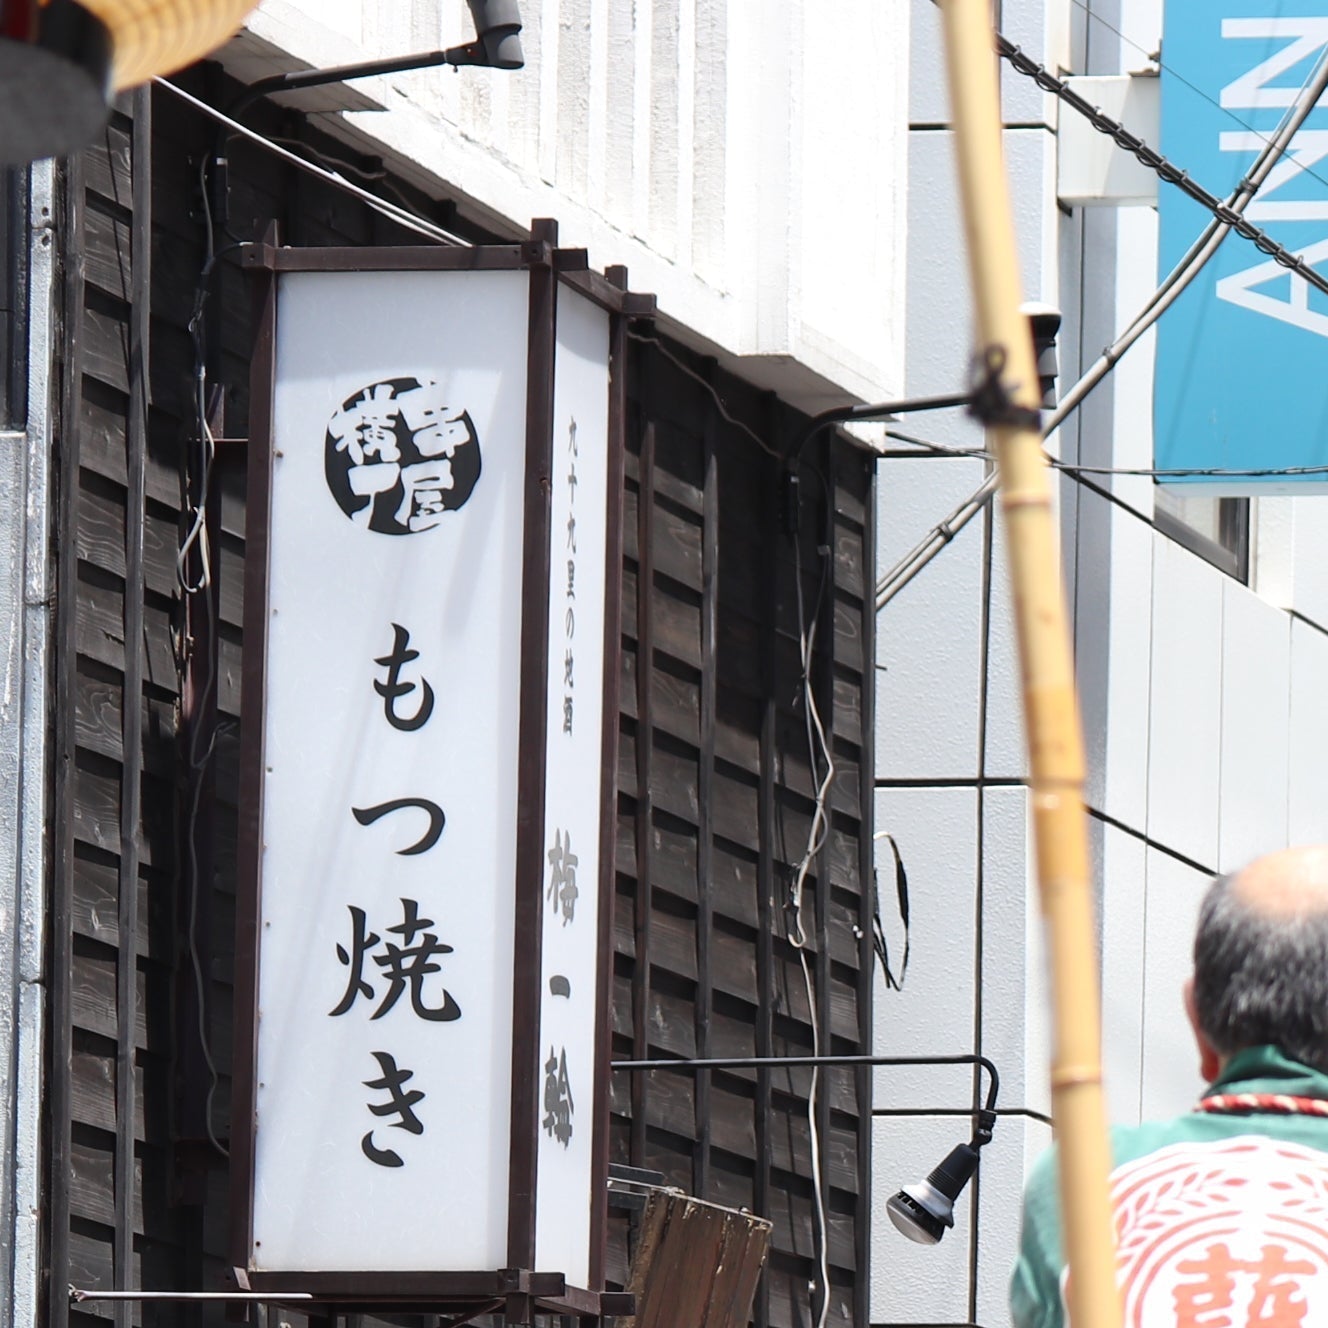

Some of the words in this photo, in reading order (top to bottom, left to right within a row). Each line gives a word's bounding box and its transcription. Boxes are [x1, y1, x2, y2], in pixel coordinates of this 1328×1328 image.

[329, 622, 462, 1168] もつ焼き
[543, 828, 579, 1150] 梅一輪
